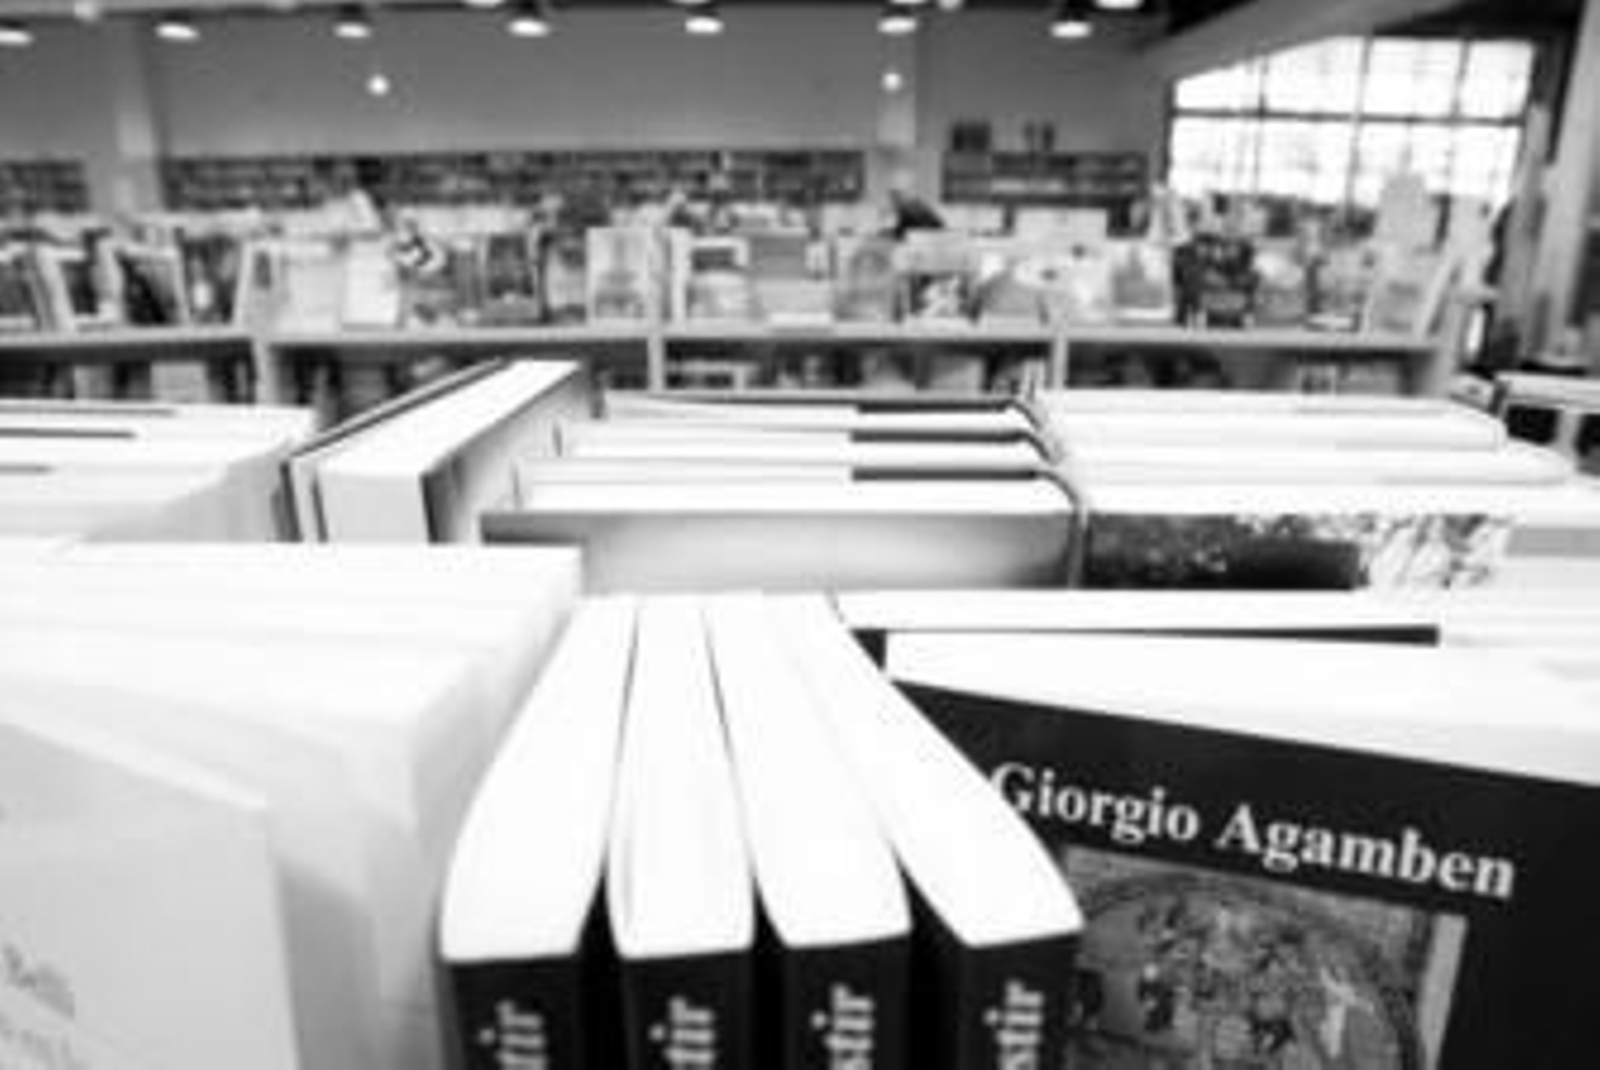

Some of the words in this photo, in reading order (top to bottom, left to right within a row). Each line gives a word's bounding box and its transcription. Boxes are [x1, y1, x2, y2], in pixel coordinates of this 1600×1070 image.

[989, 762, 1200, 844] Giorgio
[1213, 803, 1515, 898] Agamben
[479, 1001, 546, 1070] tir
